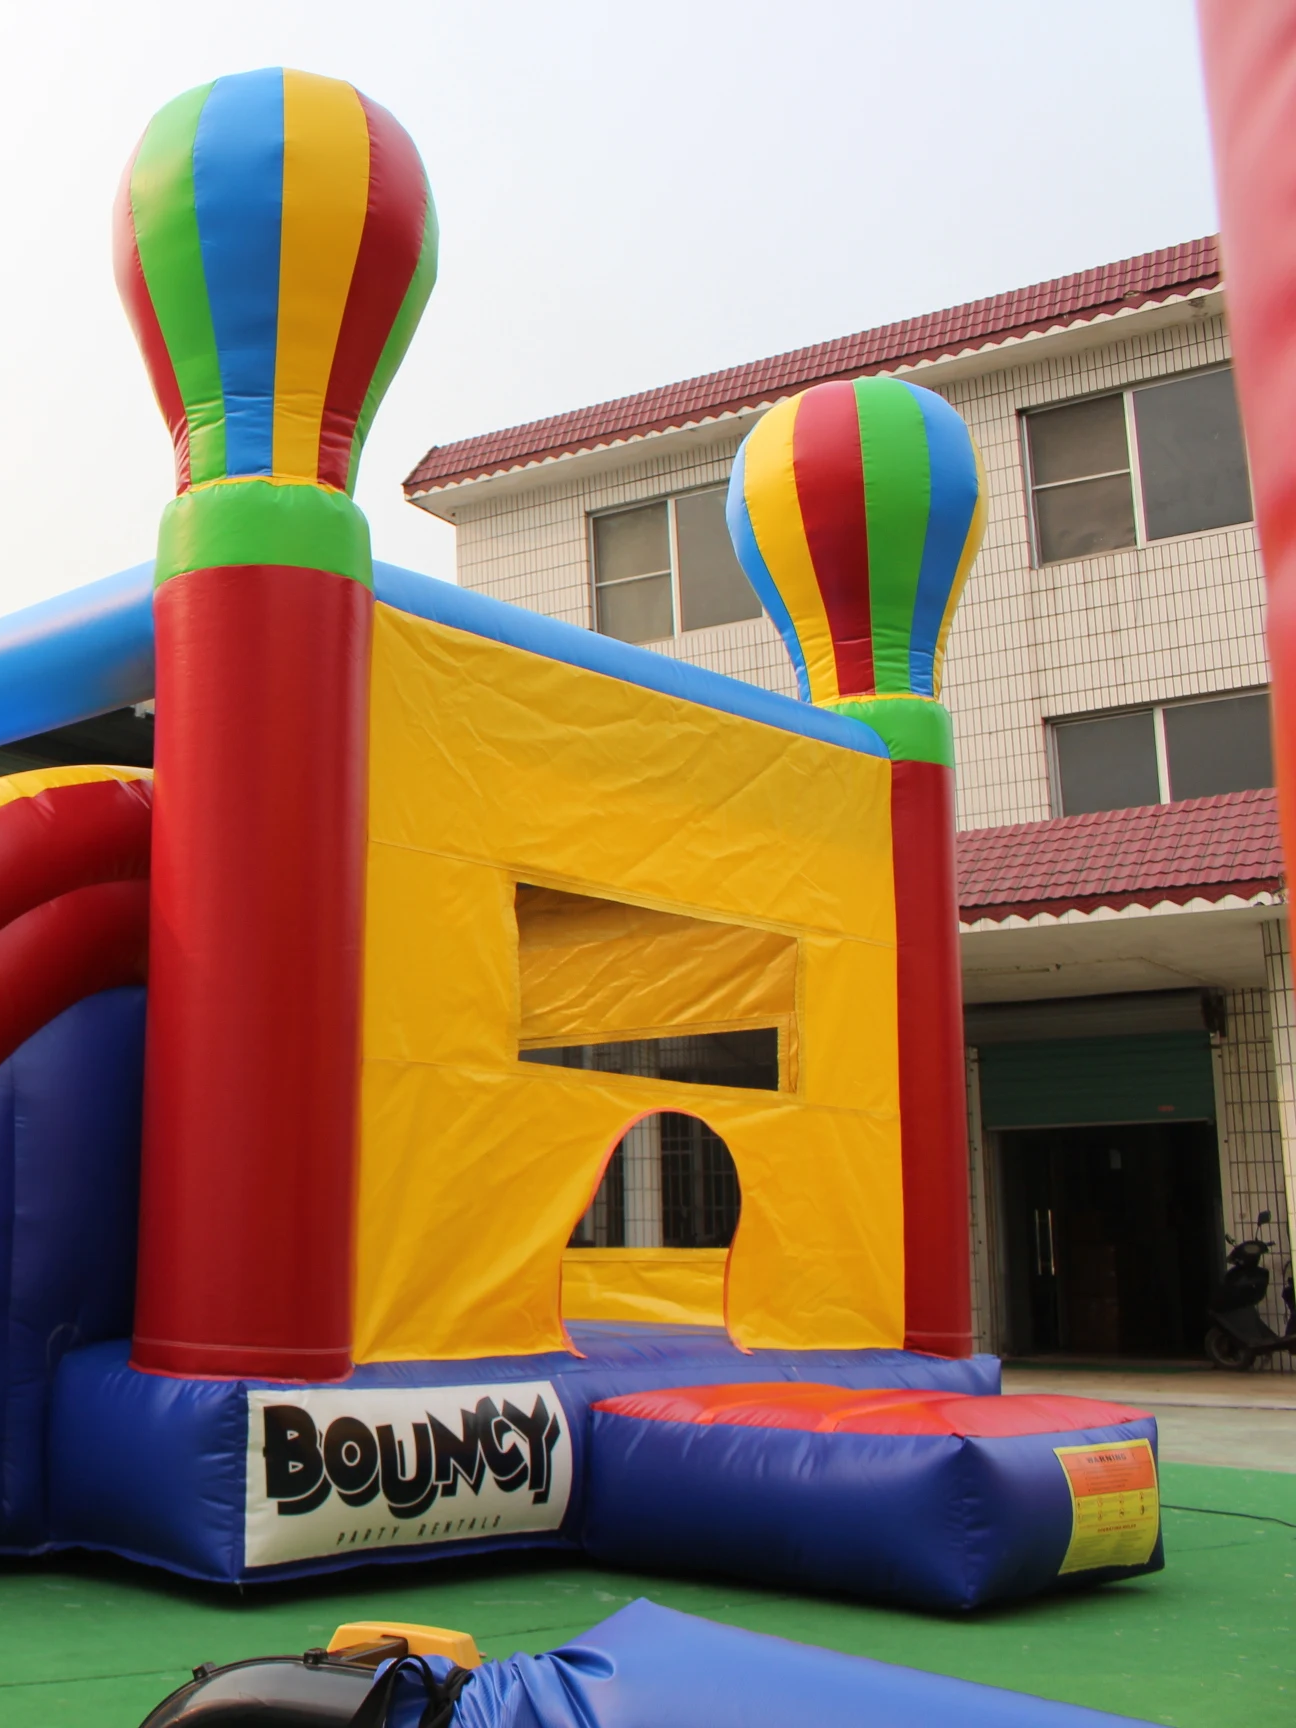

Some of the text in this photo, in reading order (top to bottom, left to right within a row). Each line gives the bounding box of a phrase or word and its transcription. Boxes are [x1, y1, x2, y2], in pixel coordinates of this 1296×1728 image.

[262, 1394, 561, 1520] BOUNCY
[1086, 1452, 1127, 1464] WARNING
[336, 1514, 502, 1546] PARTY RENTALS
